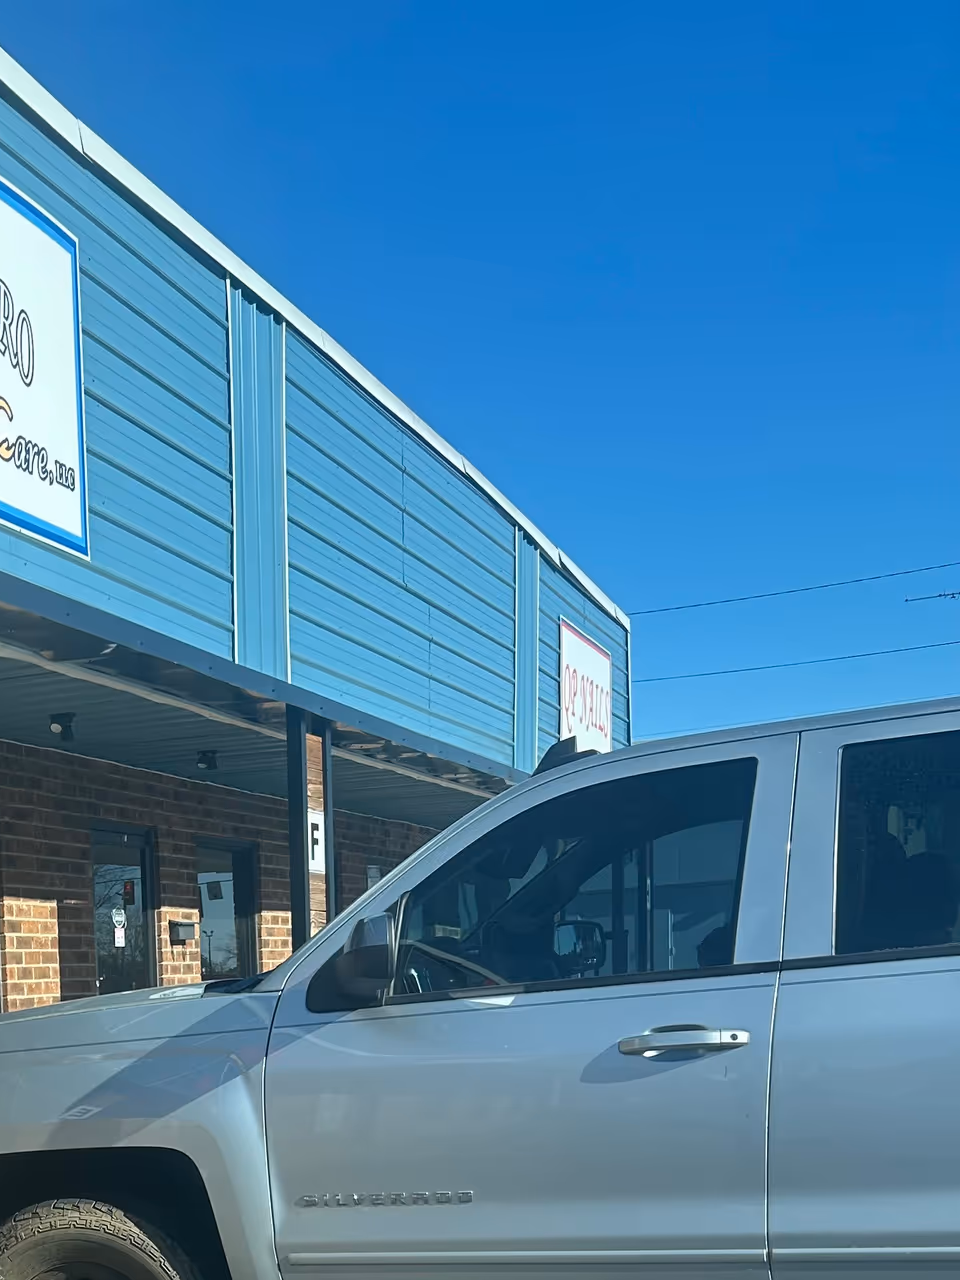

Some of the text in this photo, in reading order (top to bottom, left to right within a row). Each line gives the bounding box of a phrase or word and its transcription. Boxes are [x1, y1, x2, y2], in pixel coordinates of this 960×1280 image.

[54, 460, 76, 492] LLC
[310, 822, 320, 861] F
[299, 1190, 474, 1208] SILVERADO
